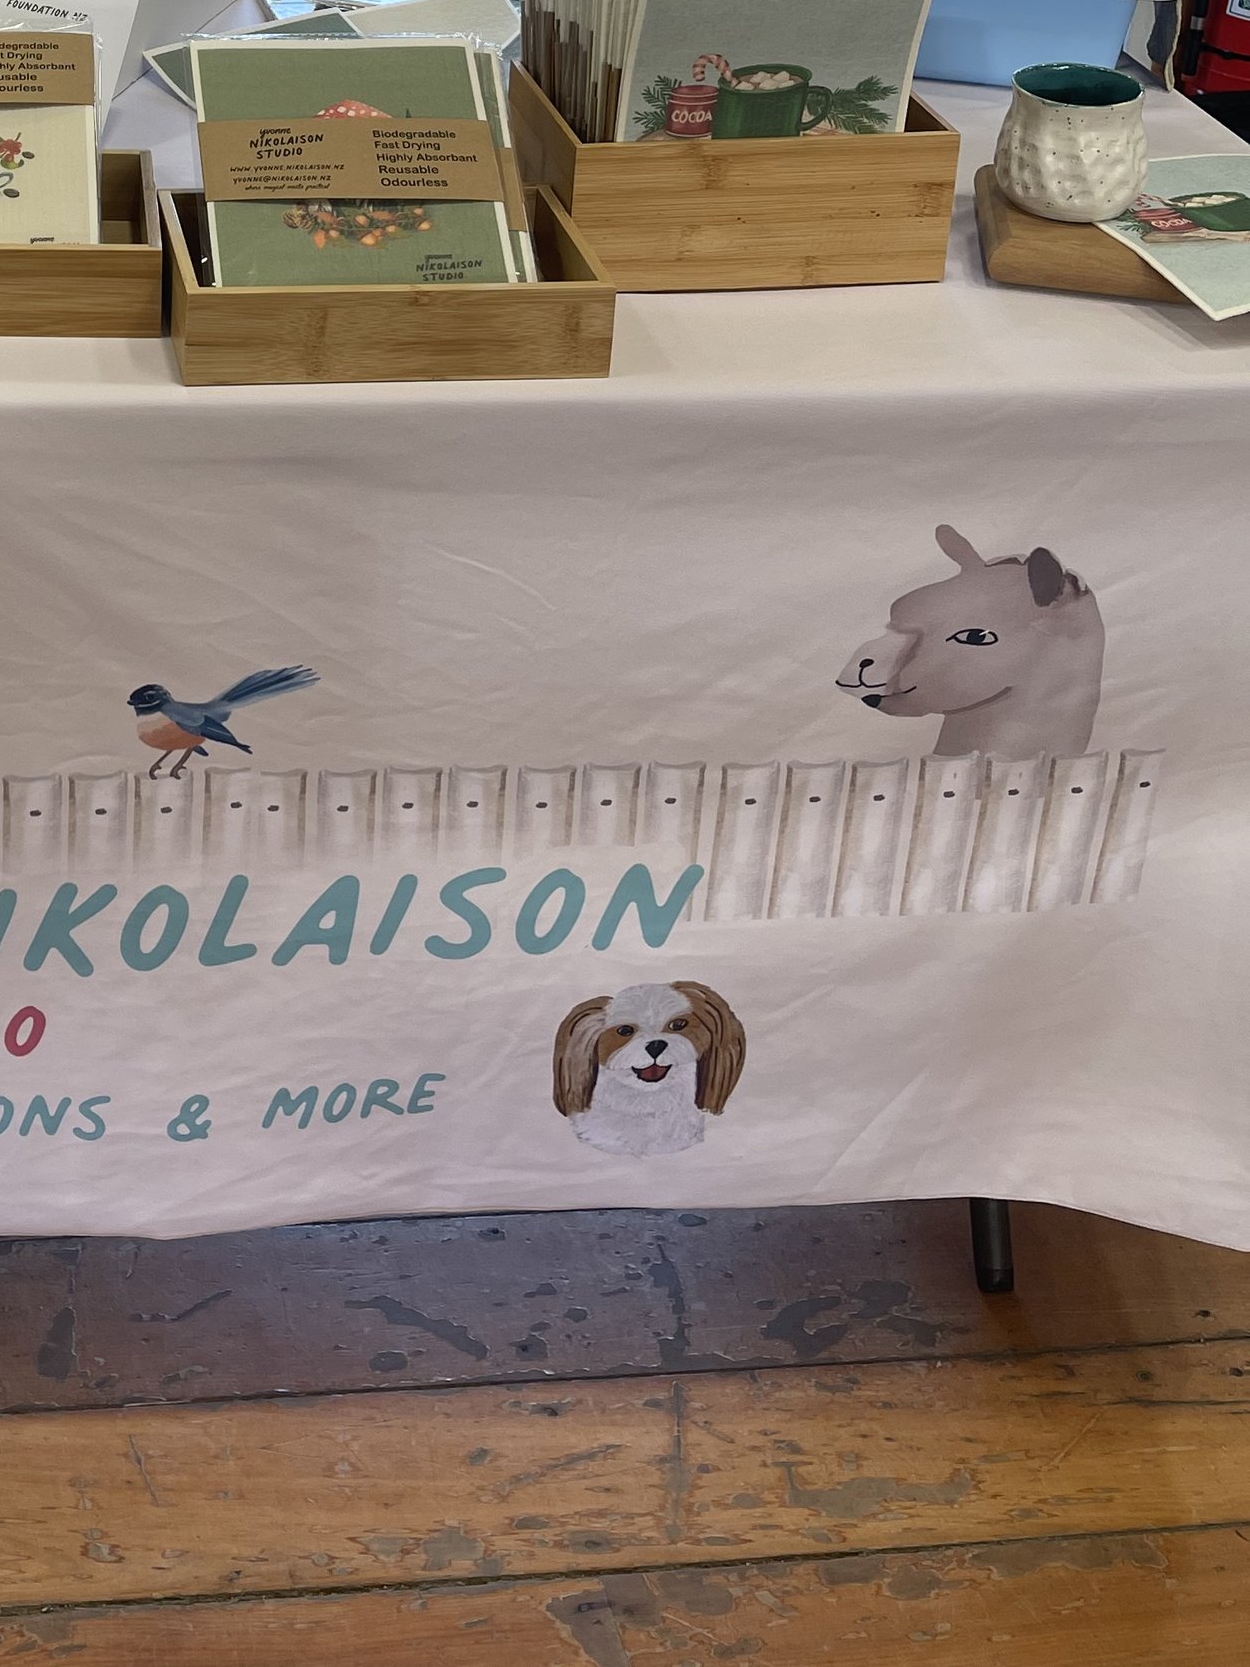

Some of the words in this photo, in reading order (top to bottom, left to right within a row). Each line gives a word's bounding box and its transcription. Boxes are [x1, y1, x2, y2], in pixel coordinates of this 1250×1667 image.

[7, 52, 43, 60] Drying
[18, 62, 76, 70] Absorbant
[671, 110, 713, 123] COCOA
[259, 128, 291, 139] yvonne
[372, 130, 456, 139] Biodegradable
[250, 134, 324, 148] NIKOLAISON
[374, 140, 399, 149] Fast
[402, 140, 441, 150] Drying
[256, 147, 303, 159] STUDIO
[376, 153, 413, 163] Highly
[416, 153, 478, 162] Absorbant
[378, 165, 439, 174] Reusable
[380, 177, 448, 187] Odourless
[416, 260, 482, 272] NIKOLAISON
[422, 272, 464, 281] STUDIO
[166, 1093, 213, 1142] &
[261, 1072, 447, 1130] MORE
